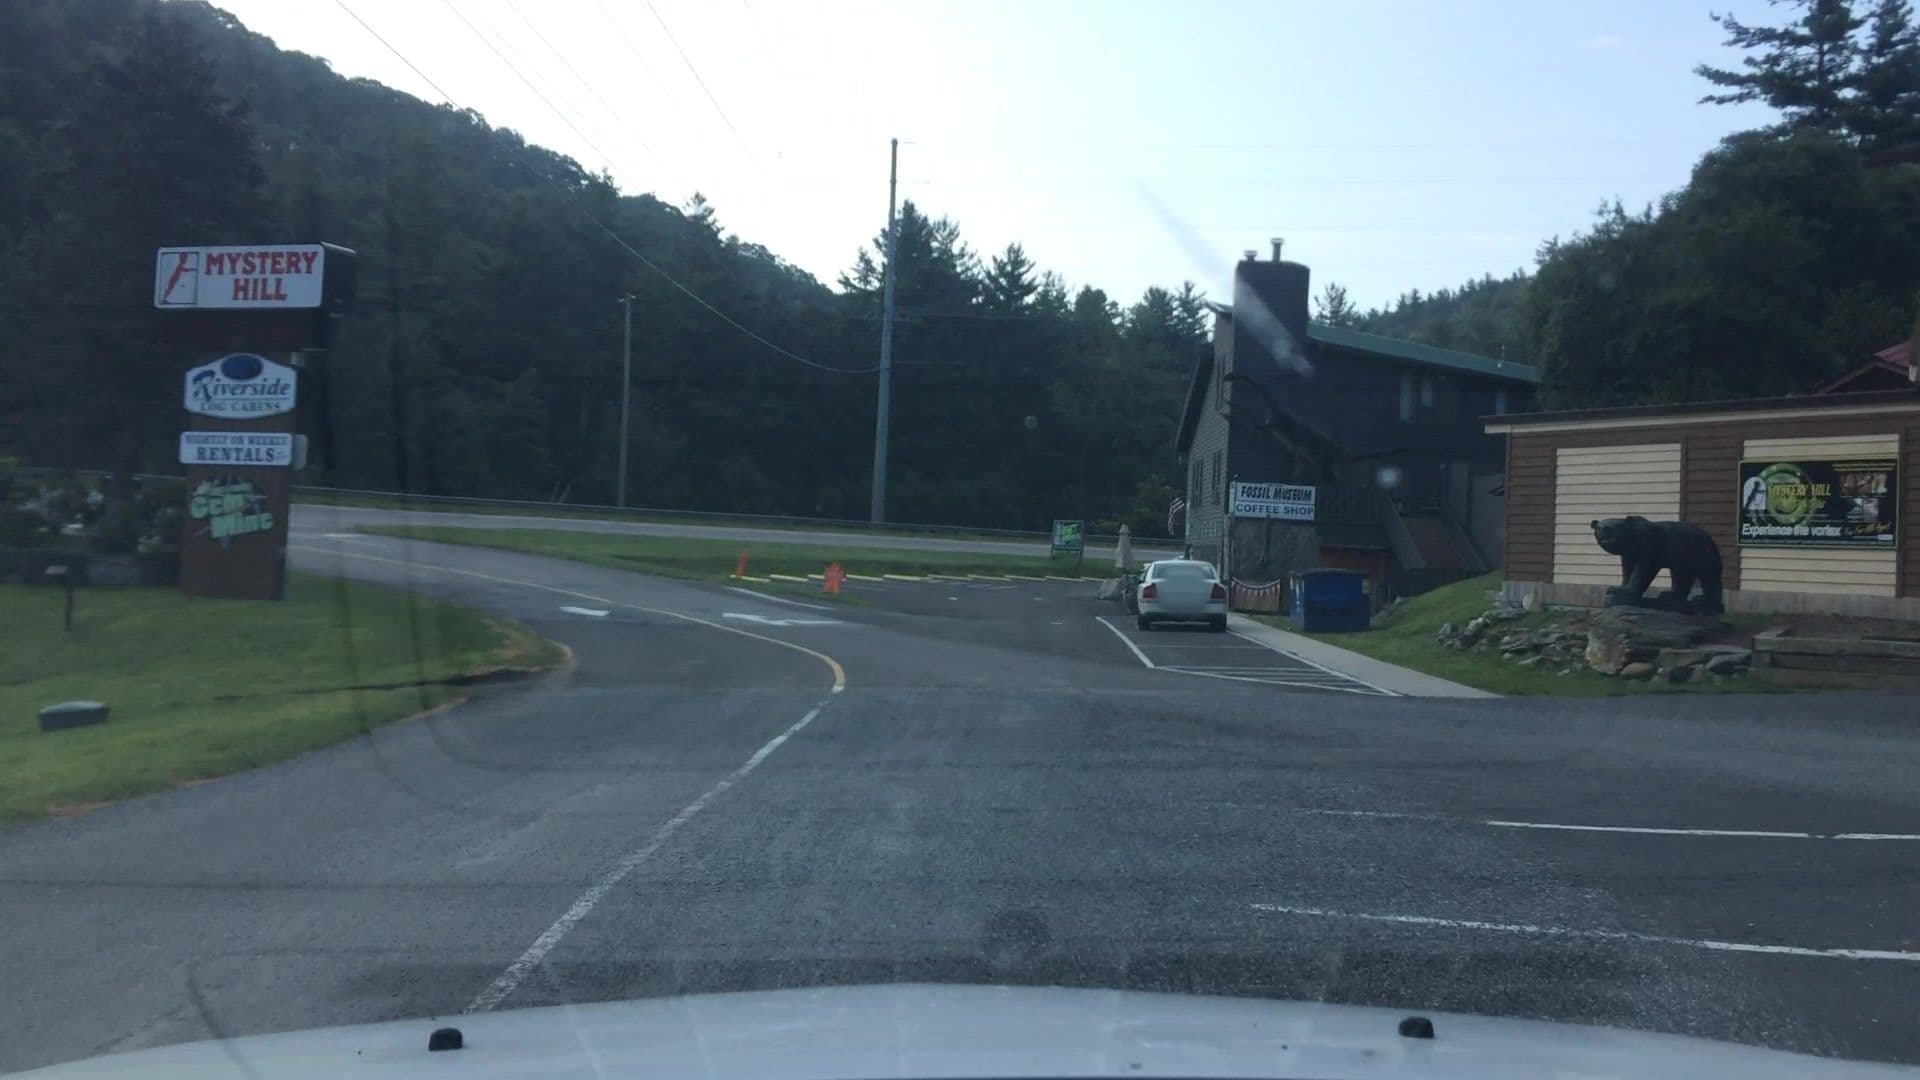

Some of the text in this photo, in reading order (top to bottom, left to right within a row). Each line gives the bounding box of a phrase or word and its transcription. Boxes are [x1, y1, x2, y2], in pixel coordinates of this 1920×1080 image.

[204, 252, 318, 275] MYSTERY
[232, 278, 288, 301] HILL
[192, 369, 290, 402] Riverside
[196, 447, 275, 463] RENTALS
[1241, 486, 1312, 500] FOSSIL MUSEUM
[1236, 504, 1314, 516] COFFEE SHOP
[1742, 524, 1793, 537] Experience
[1794, 525, 1809, 536] the
